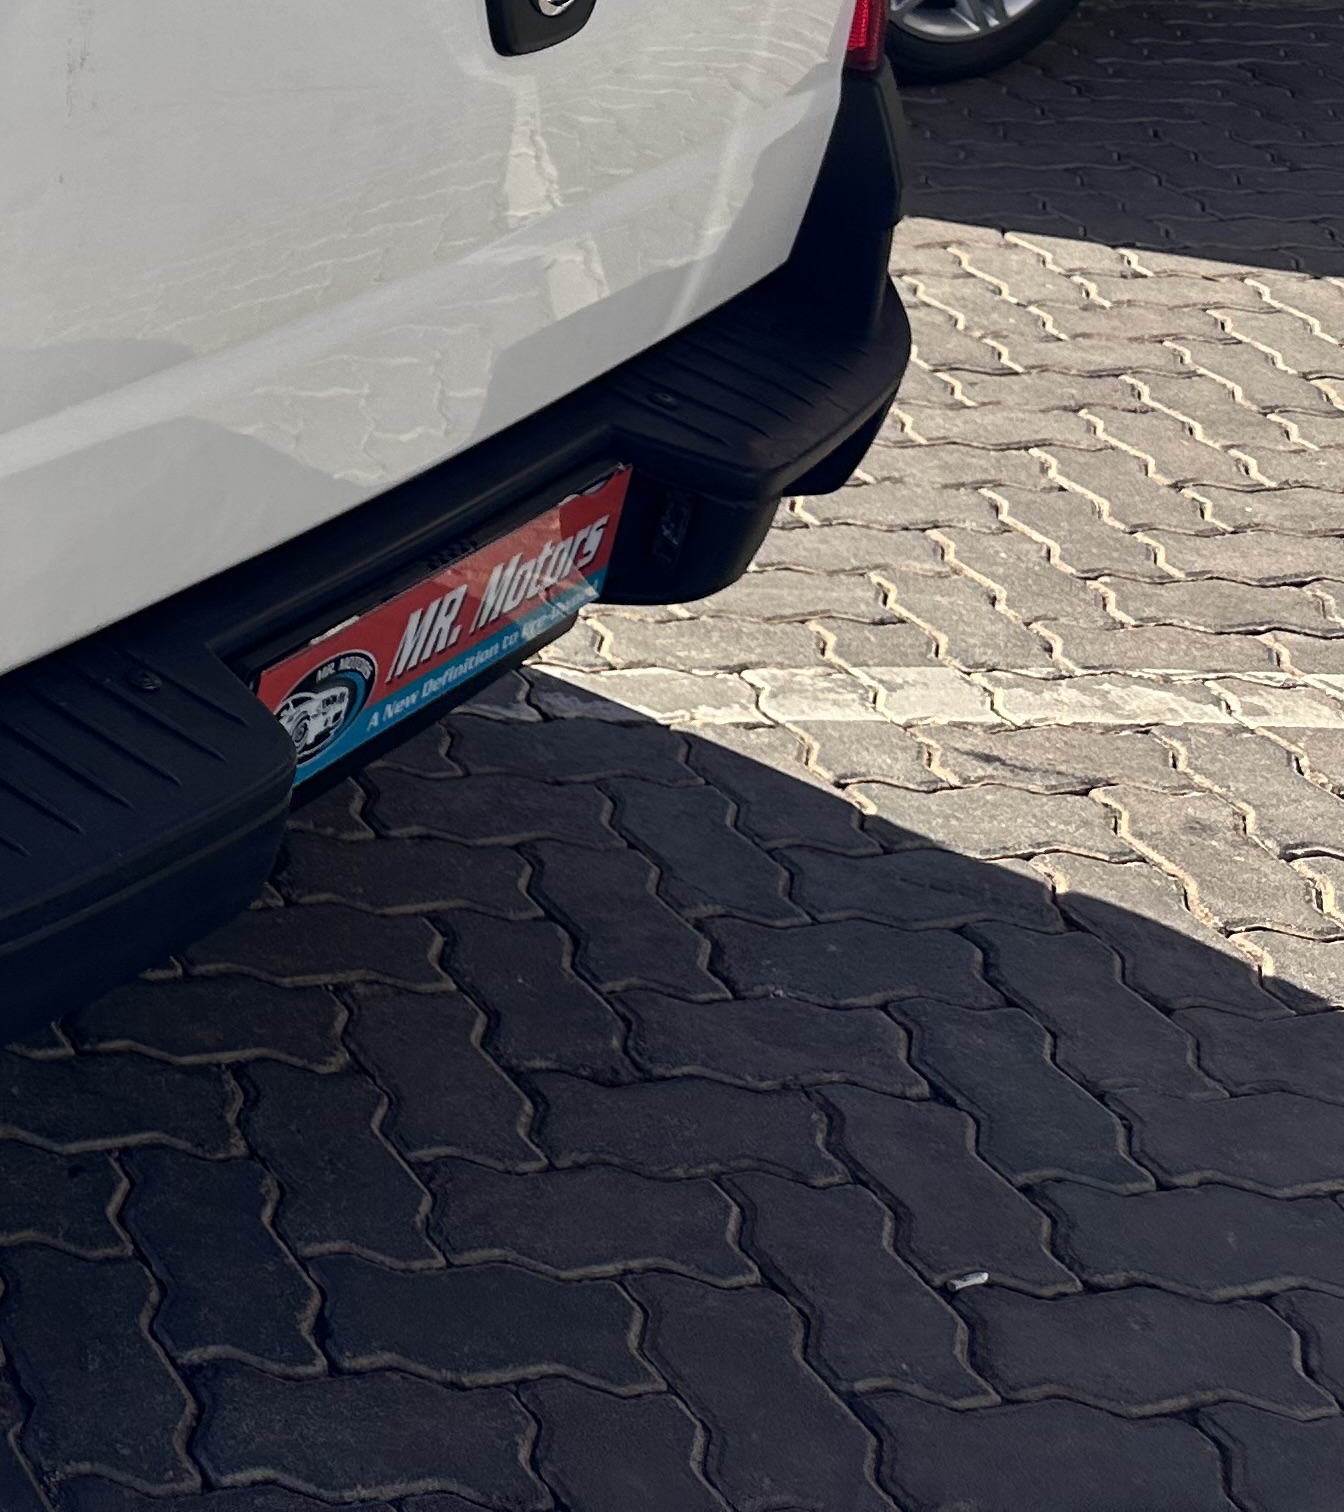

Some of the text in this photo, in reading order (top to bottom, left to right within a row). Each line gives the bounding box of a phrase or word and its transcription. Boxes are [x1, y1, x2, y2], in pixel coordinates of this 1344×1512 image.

[385, 515, 609, 685] MR. Motors
[366, 711, 380, 732] A
[382, 689, 419, 723] New
[421, 645, 499, 698] Definition
[502, 631, 520, 652] to
